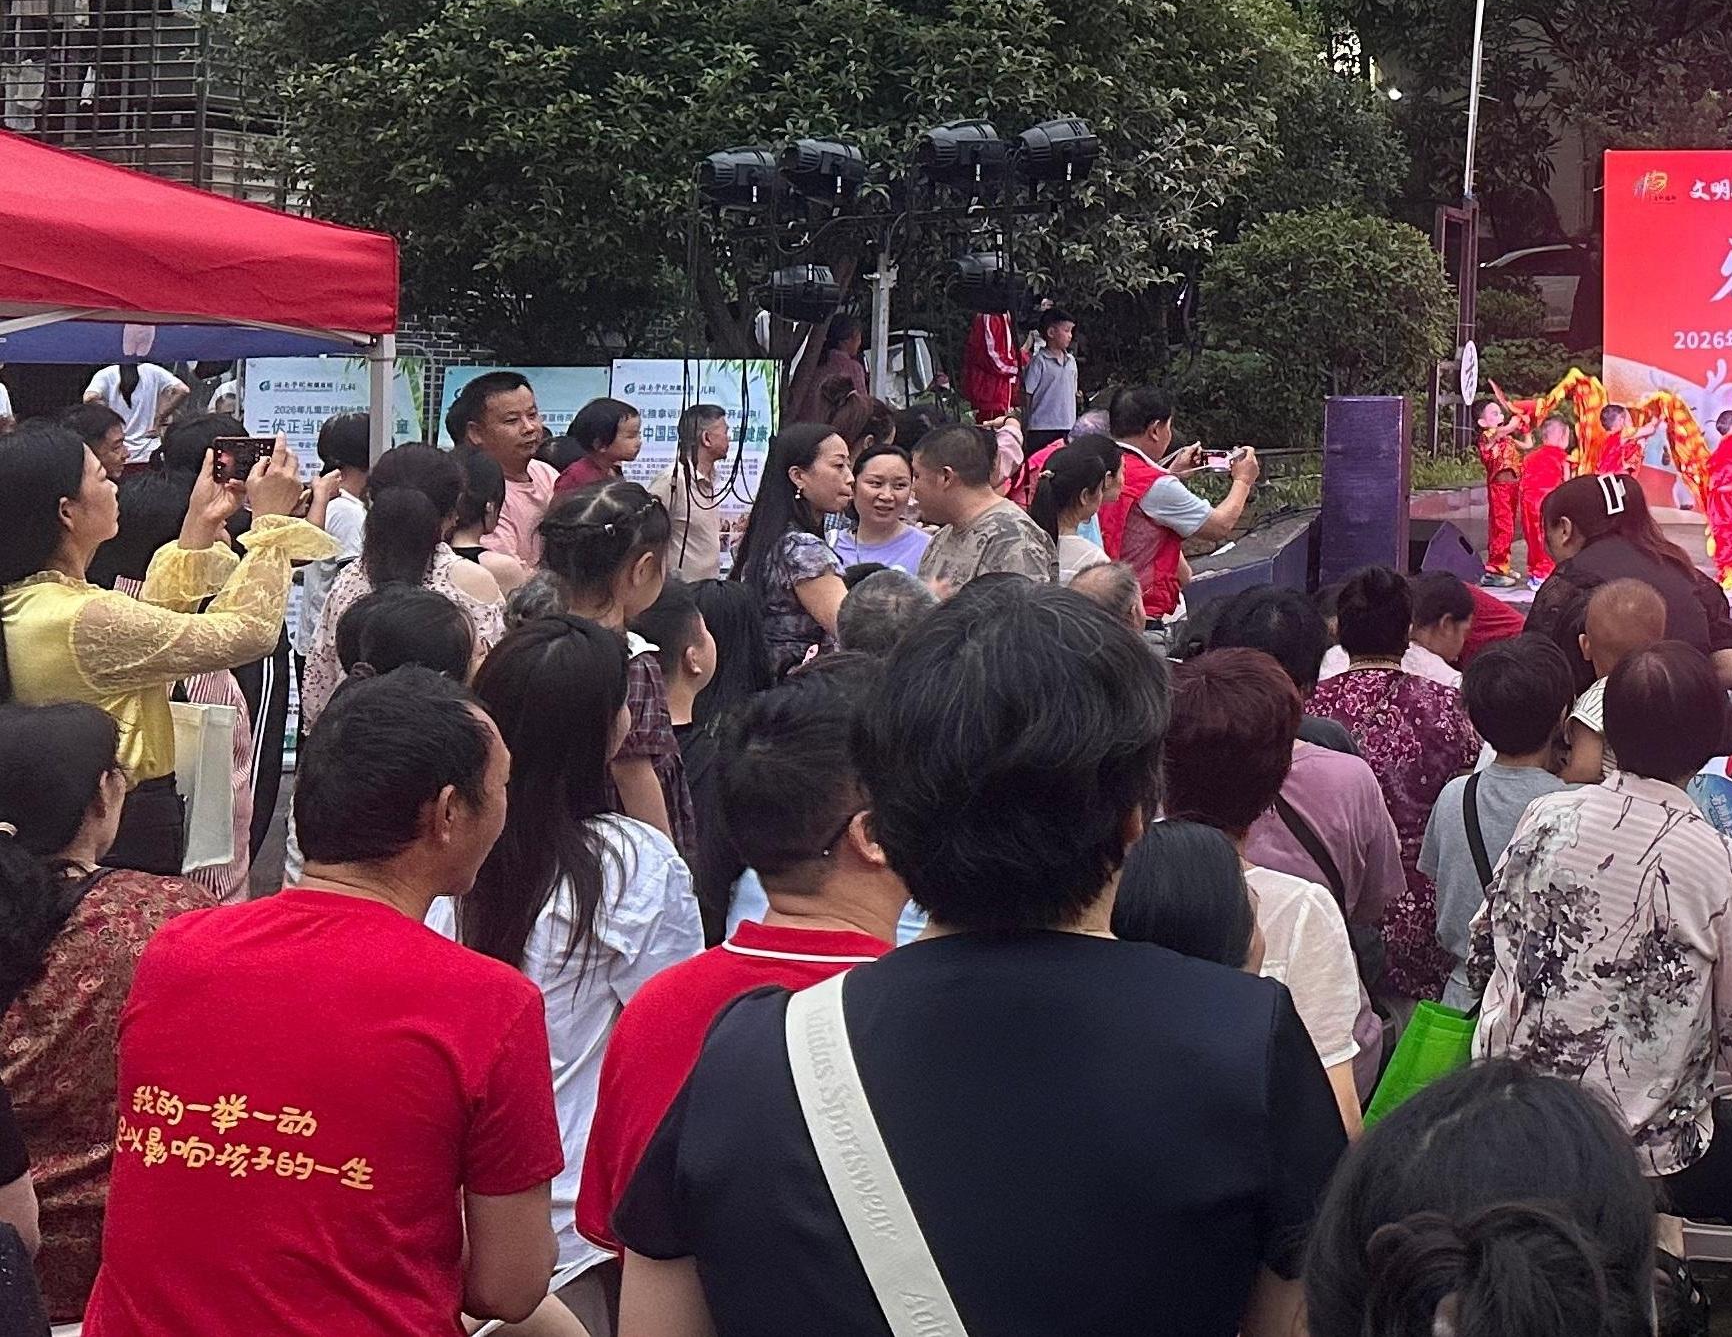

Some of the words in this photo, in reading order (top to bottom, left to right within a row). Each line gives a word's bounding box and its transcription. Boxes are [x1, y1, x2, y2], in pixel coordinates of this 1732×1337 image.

[132, 1085, 318, 1137] 我的一举一动
